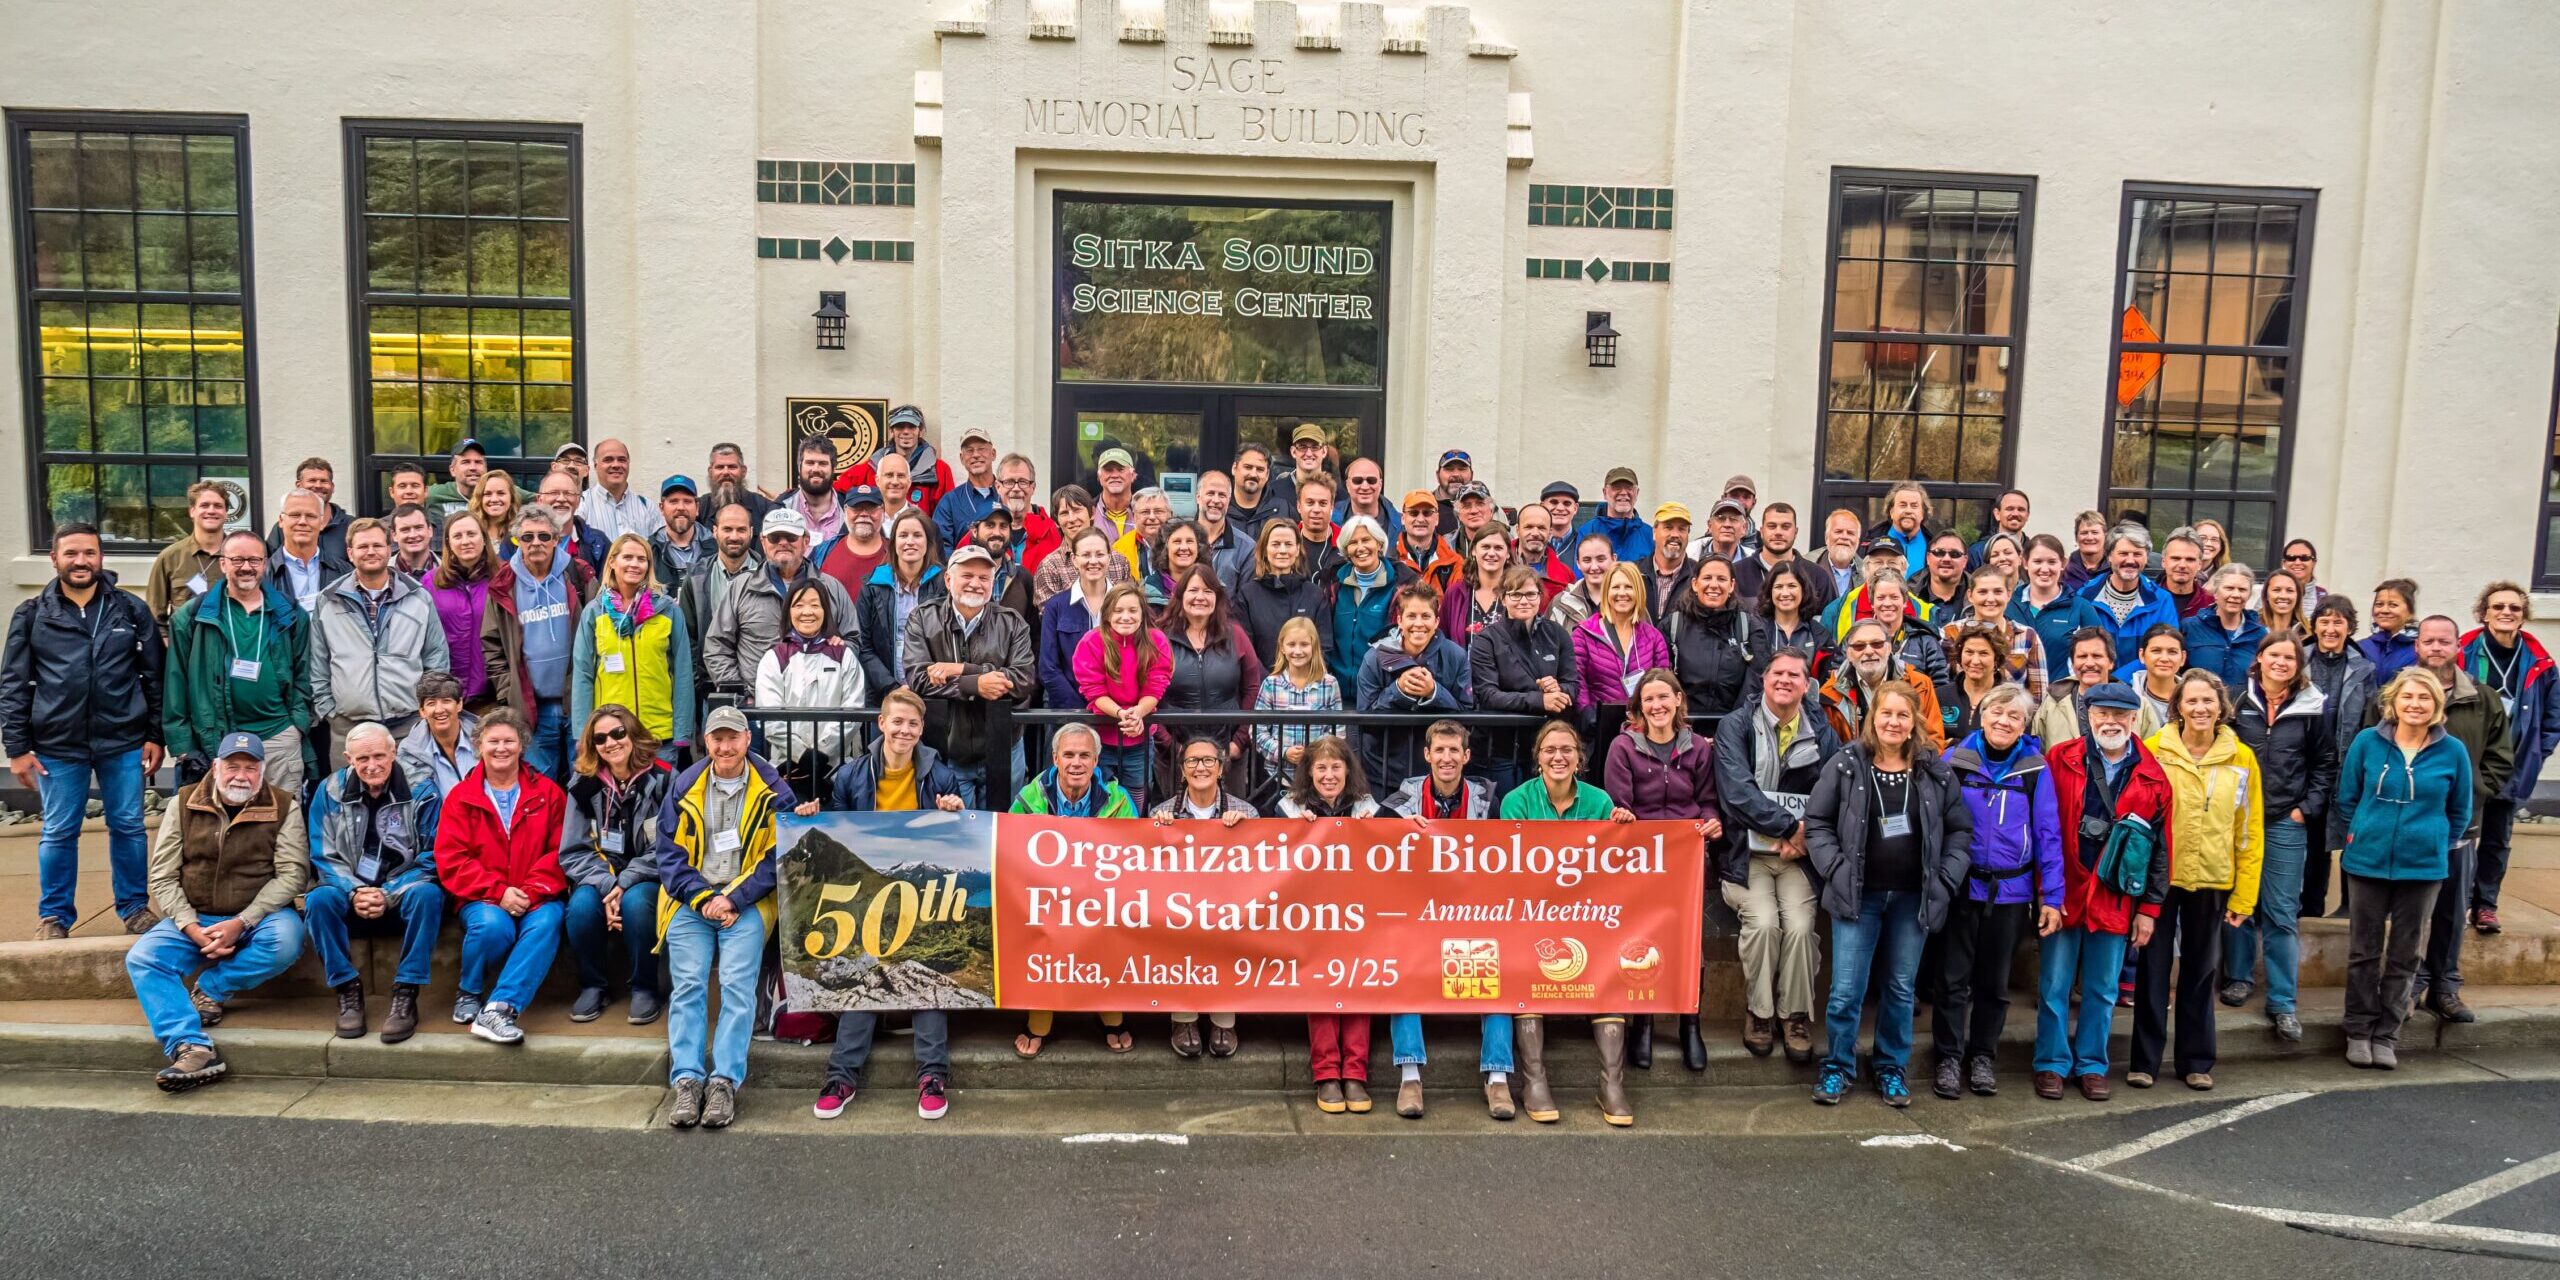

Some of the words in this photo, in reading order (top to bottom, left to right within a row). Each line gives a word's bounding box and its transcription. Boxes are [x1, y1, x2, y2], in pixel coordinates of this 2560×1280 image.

[1172, 55, 1285, 95] SAGE
[1024, 99, 1215, 141] MEMORIAL
[1241, 106, 1428, 147] BUILDING
[1072, 233, 1205, 271] SITKA
[1222, 237, 1374, 275] SOUND
[1072, 283, 1222, 317] SCIENCE
[1234, 287, 1373, 320] CENTER
[1776, 795, 1807, 809] UCN
[1026, 829, 1353, 882] Organization
[1366, 832, 1420, 874] of
[1428, 834, 1667, 887] Biological
[804, 872, 968, 960] 50th
[1025, 886, 1152, 929] Field
[1164, 889, 1366, 932] Stations
[1418, 898, 1513, 923] Annual
[1519, 898, 1623, 929] Meeting
[1027, 953, 1111, 989] Sitka,
[1117, 955, 1220, 986] Alaska
[1234, 957, 1301, 988] 9/21
[1443, 959, 1498, 978] OBFS
[1531, 984, 1558, 992] SITKA
[1561, 984, 1595, 992] SOUND
